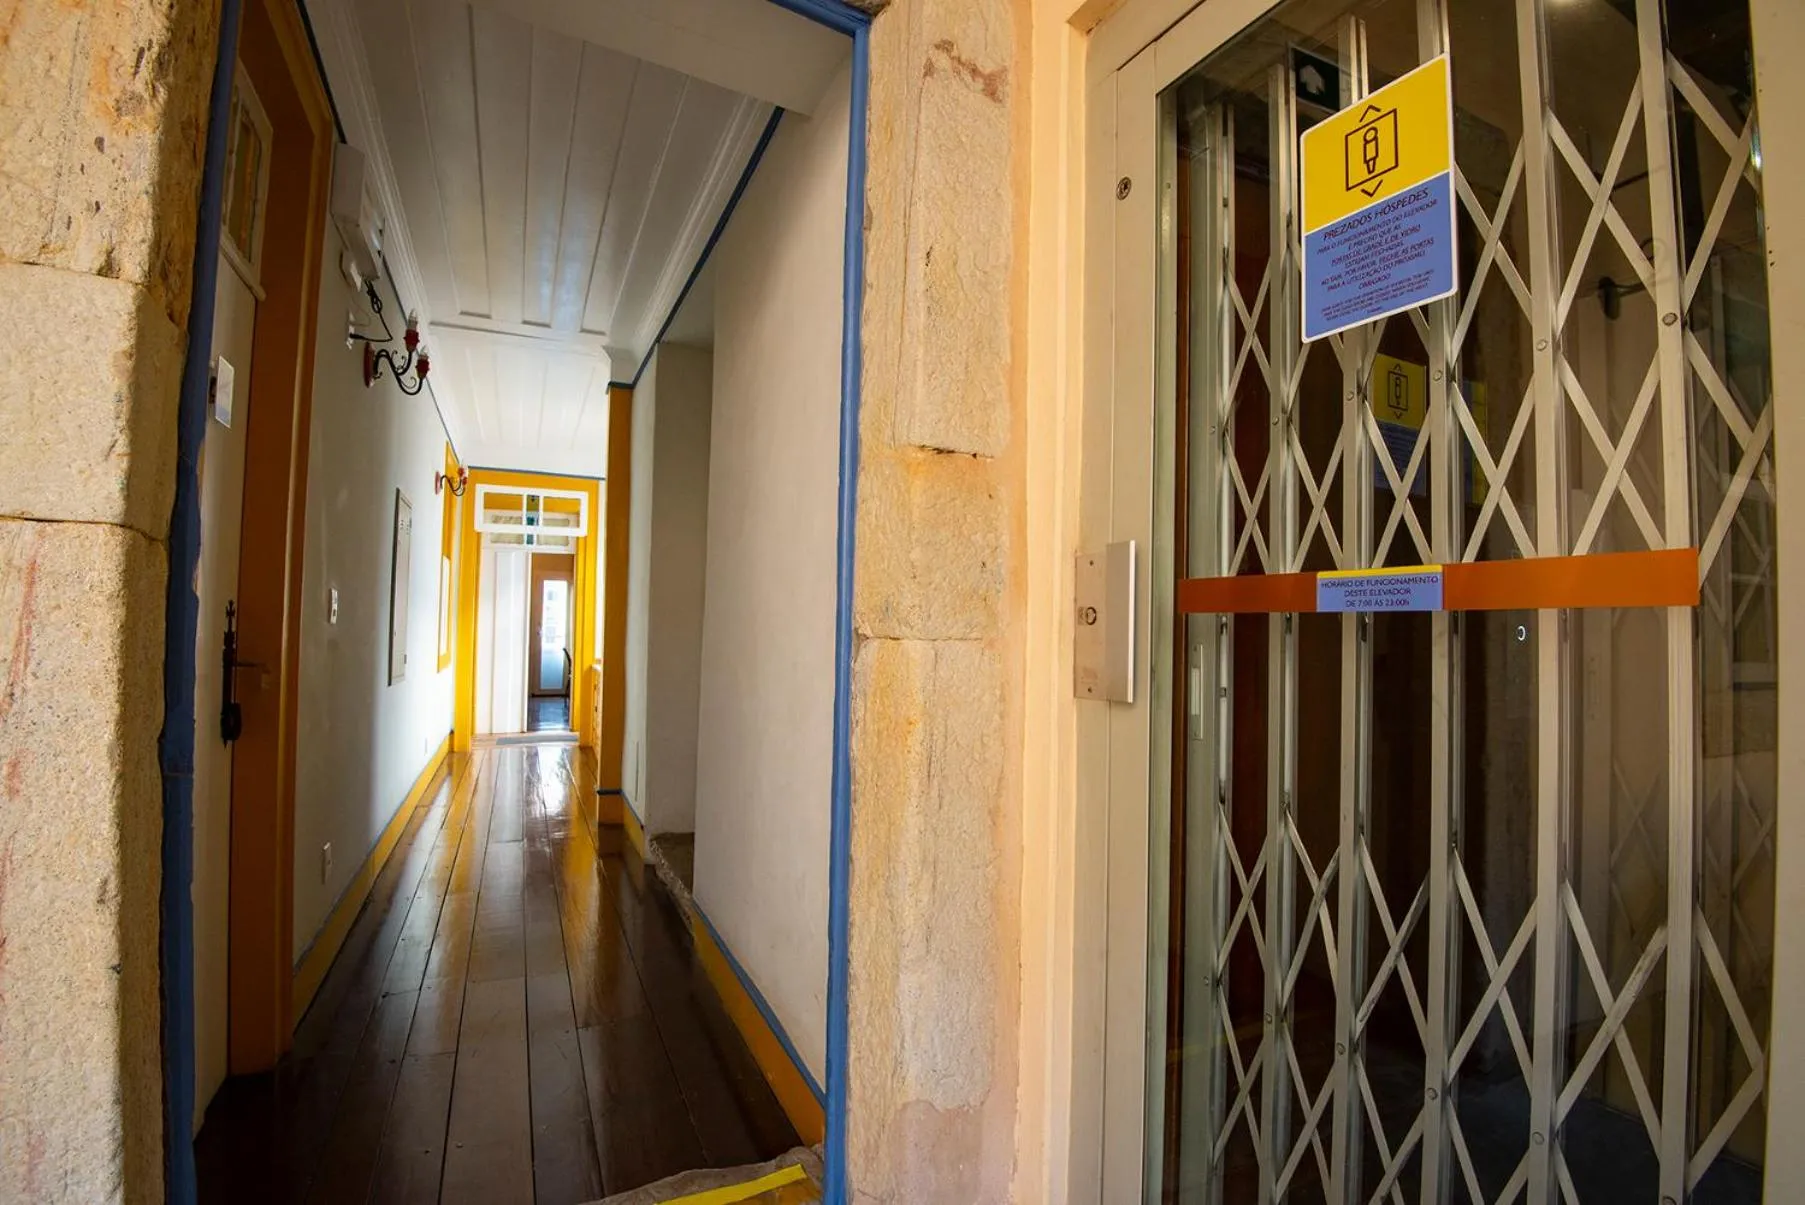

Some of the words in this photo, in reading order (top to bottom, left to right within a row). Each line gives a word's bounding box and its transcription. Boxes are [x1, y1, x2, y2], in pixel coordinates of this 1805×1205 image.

[1403, 198, 1437, 218] ELEVADOR
[1323, 213, 1372, 240] PREZADOS
[1354, 579, 1365, 588] DE
[1366, 575, 1439, 587] FUNCIONAMENTO
[1344, 588, 1368, 597] DESTE
[1369, 587, 1411, 597] ELEVADOR
[1345, 600, 1356, 608] DE
